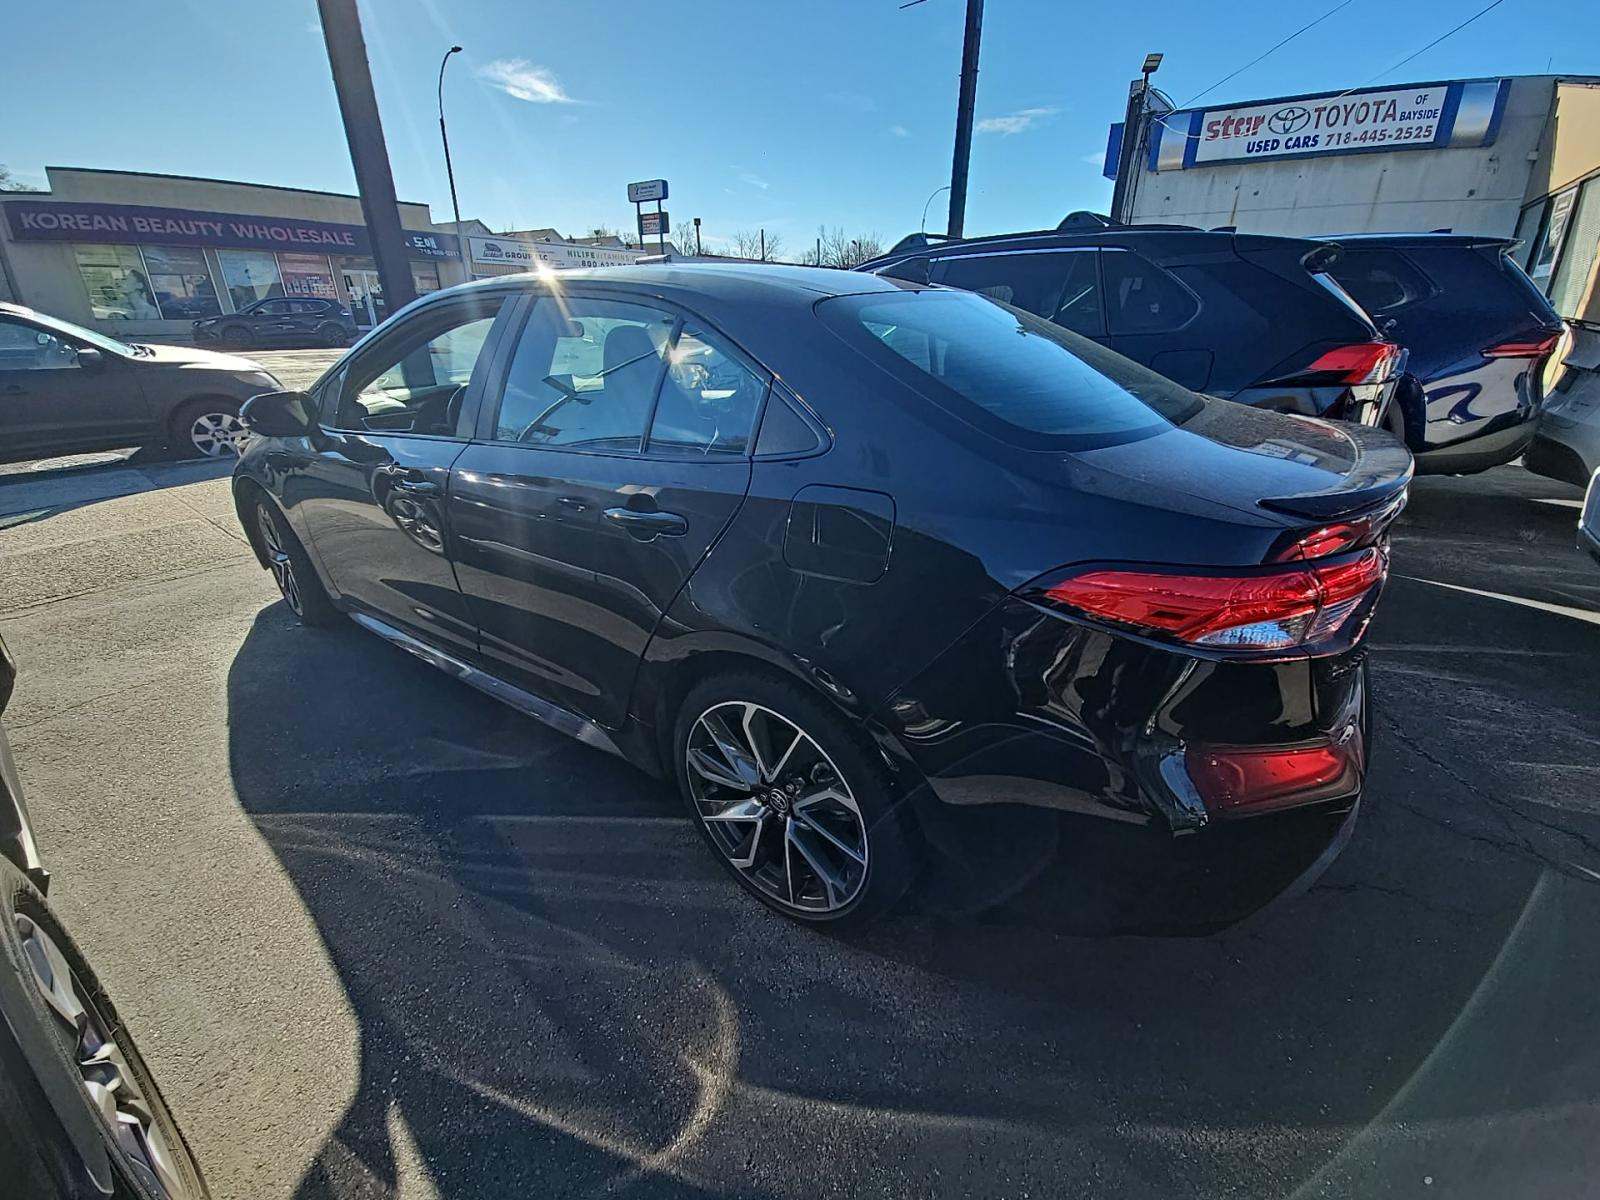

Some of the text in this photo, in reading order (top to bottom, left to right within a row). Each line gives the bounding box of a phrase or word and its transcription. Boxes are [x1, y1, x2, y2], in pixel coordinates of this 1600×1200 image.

[1415, 94, 1429, 106] OF
[1205, 99, 1398, 142] star TOYOTA
[1399, 108, 1440, 122] BAYSIDE
[1246, 125, 1433, 154] USED CARS 718-445-2525
[20, 212, 356, 246] KOREAN BEAUTY WHOLESALE
